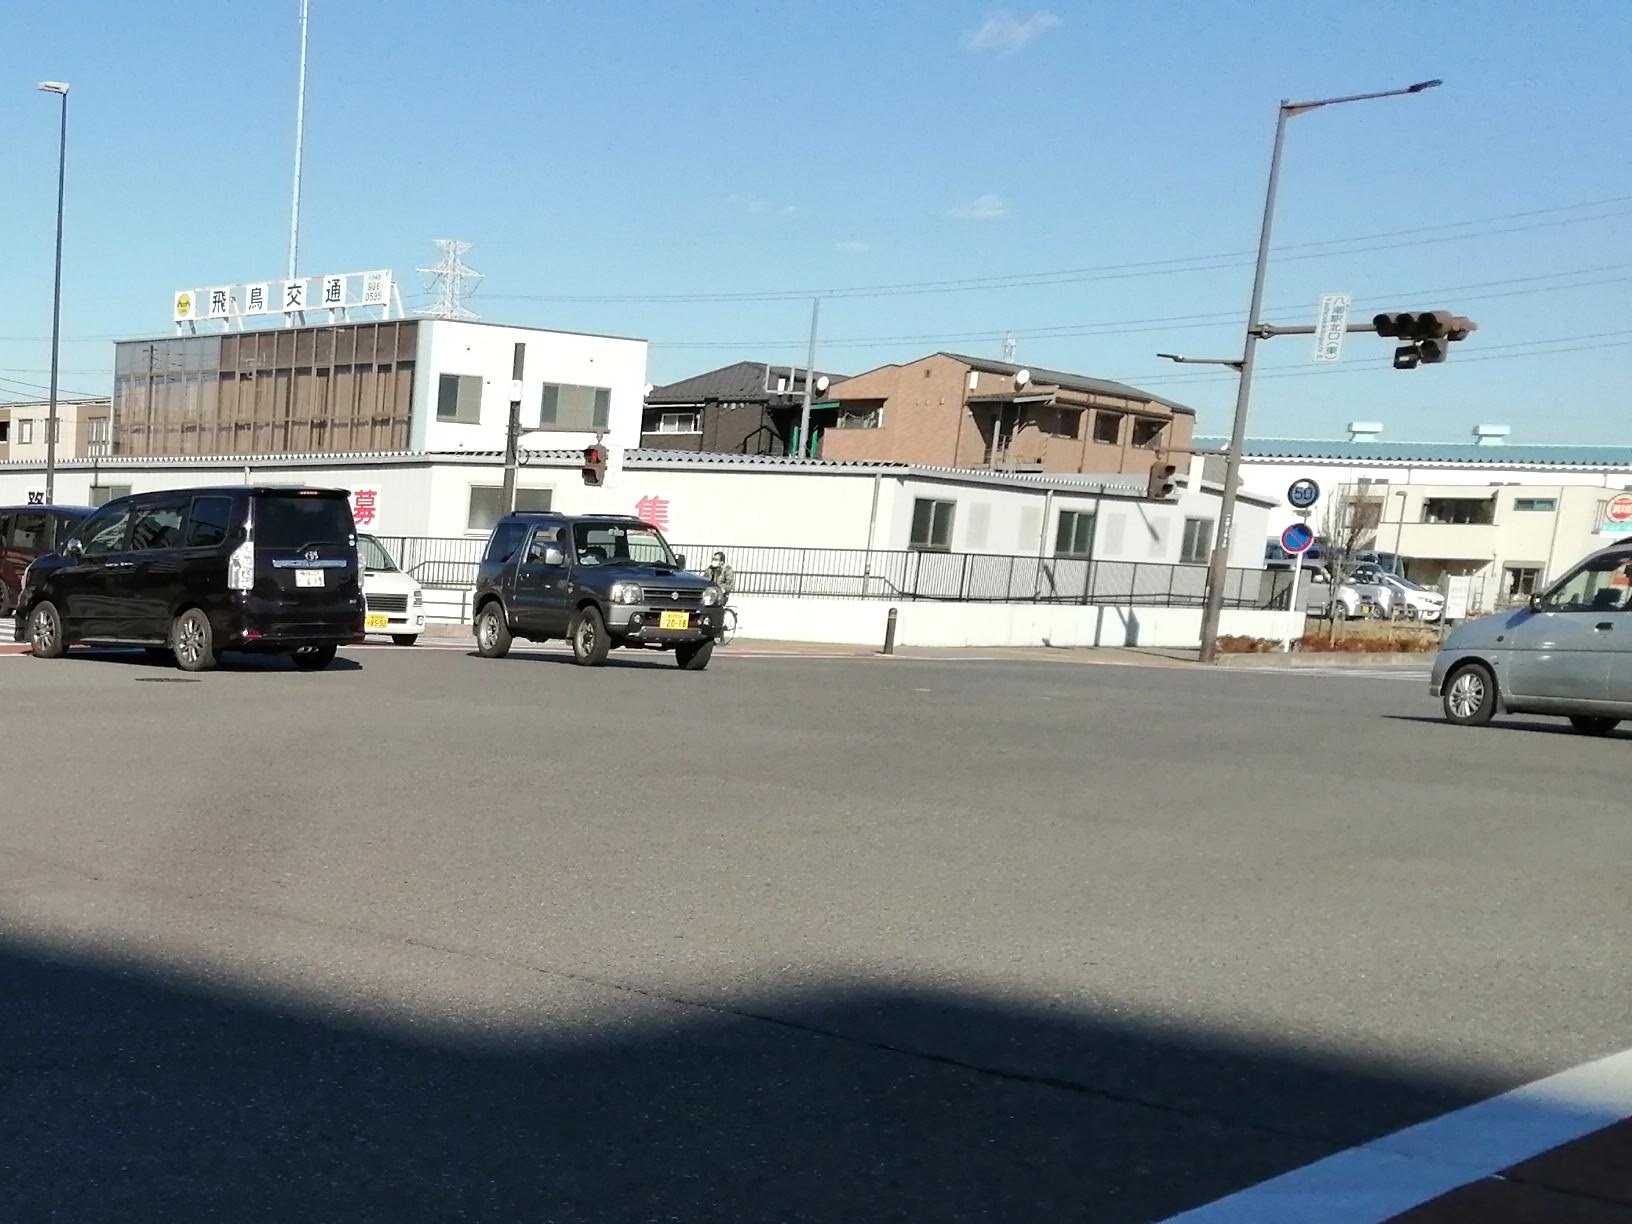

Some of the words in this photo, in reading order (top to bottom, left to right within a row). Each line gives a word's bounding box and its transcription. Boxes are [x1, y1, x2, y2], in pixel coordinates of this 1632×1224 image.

[212, 279, 341, 314] 飛鳥交通
[1294, 486, 1313, 500] 50
[353, 489, 378, 526] 募
[634, 495, 670, 533] 集
